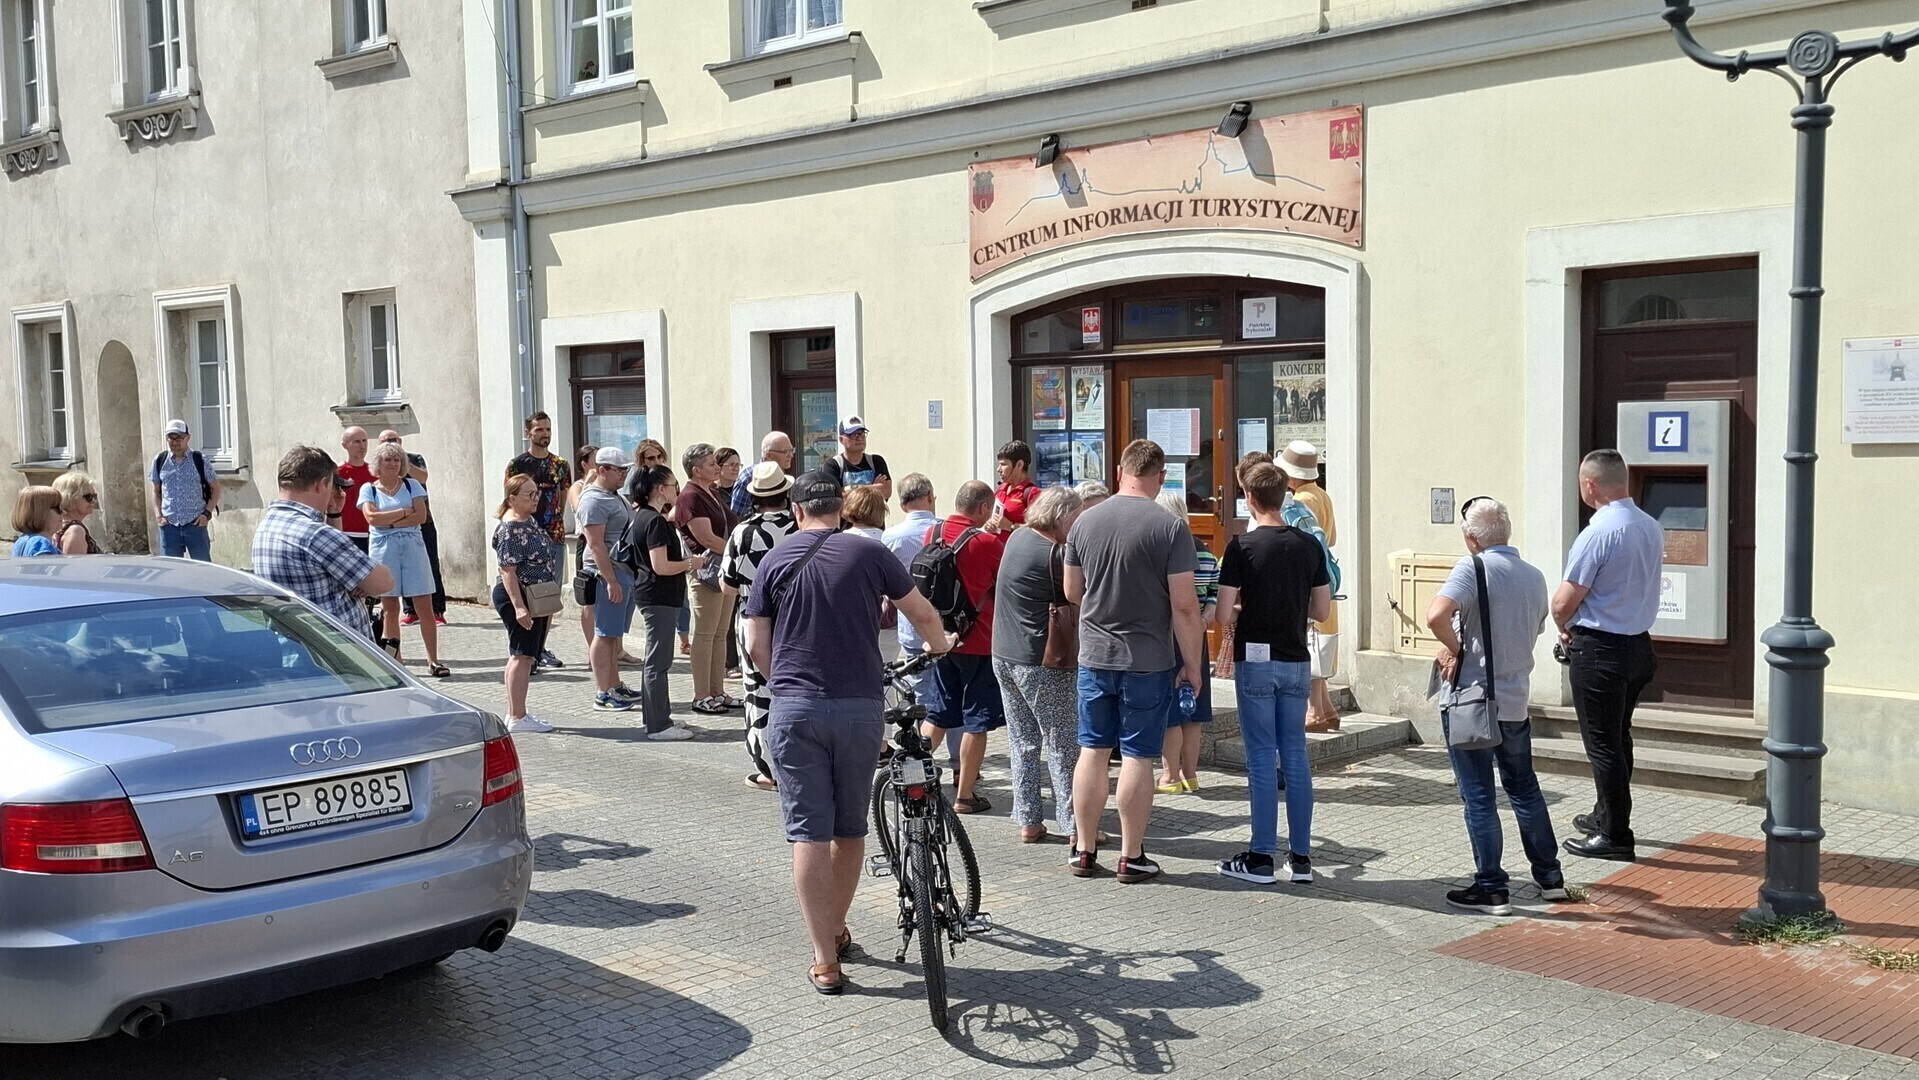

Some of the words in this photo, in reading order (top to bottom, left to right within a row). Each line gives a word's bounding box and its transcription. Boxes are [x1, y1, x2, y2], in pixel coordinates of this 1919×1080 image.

[973, 222, 1058, 265] CENTRUM
[1063, 200, 1184, 235] INFORMACJI
[1189, 198, 1360, 233] TURYSTYCZNEJ
[1072, 366, 1104, 375] WYSTAWA
[1280, 363, 1326, 377] KONCERT
[262, 791, 301, 826] EP
[314, 775, 401, 815] 89885
[246, 818, 258, 827] PL
[285, 820, 316, 831] Grenzen.de
[316, 814, 356, 826] Geländewagen
[356, 809, 380, 820] Spezialist
[169, 850, 204, 865] A6
